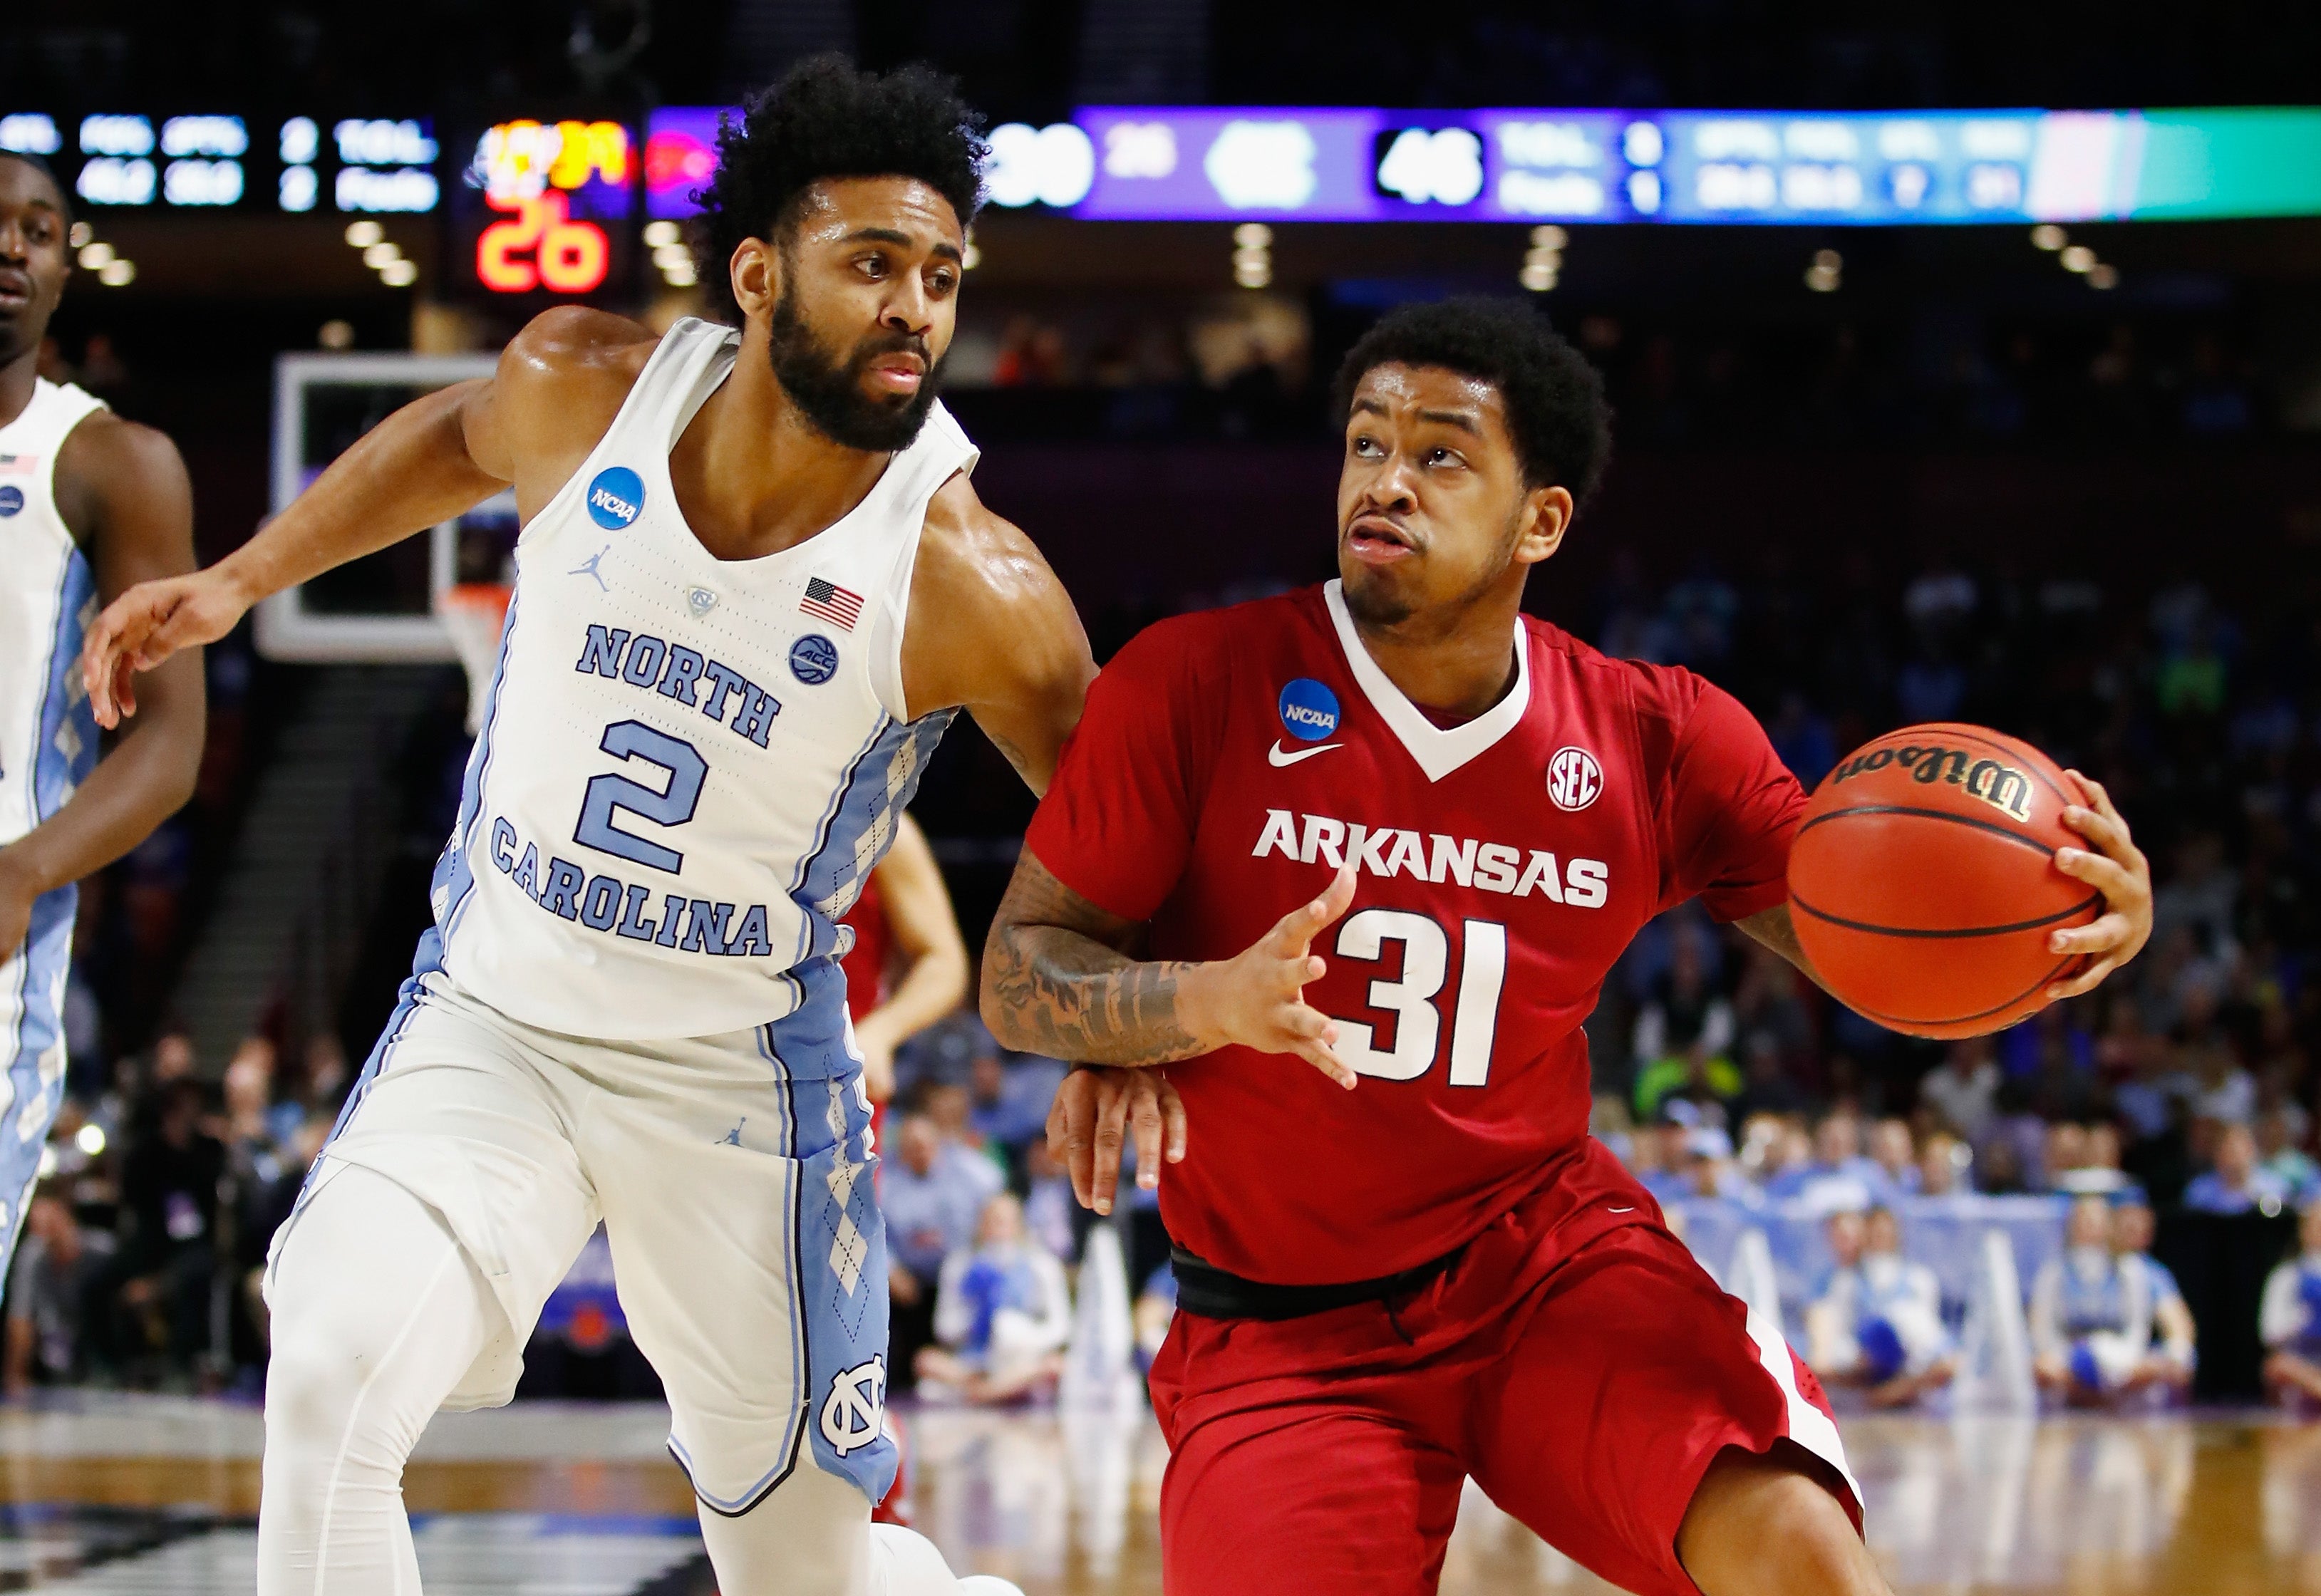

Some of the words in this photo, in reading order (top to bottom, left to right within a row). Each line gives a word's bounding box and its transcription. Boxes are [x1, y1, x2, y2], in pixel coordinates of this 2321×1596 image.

[591, 488, 637, 523] NCAA
[576, 624, 782, 749] NORTH
[798, 650, 837, 670] ACC
[1285, 703, 1336, 730] NCAA
[573, 719, 709, 875] 2
[1551, 751, 1598, 807] SEC
[1833, 745, 2035, 823] Wilson
[490, 816, 772, 958] CAROLINA
[1251, 808, 1608, 910] ARKANSAS
[1330, 908, 1508, 1088] 31
